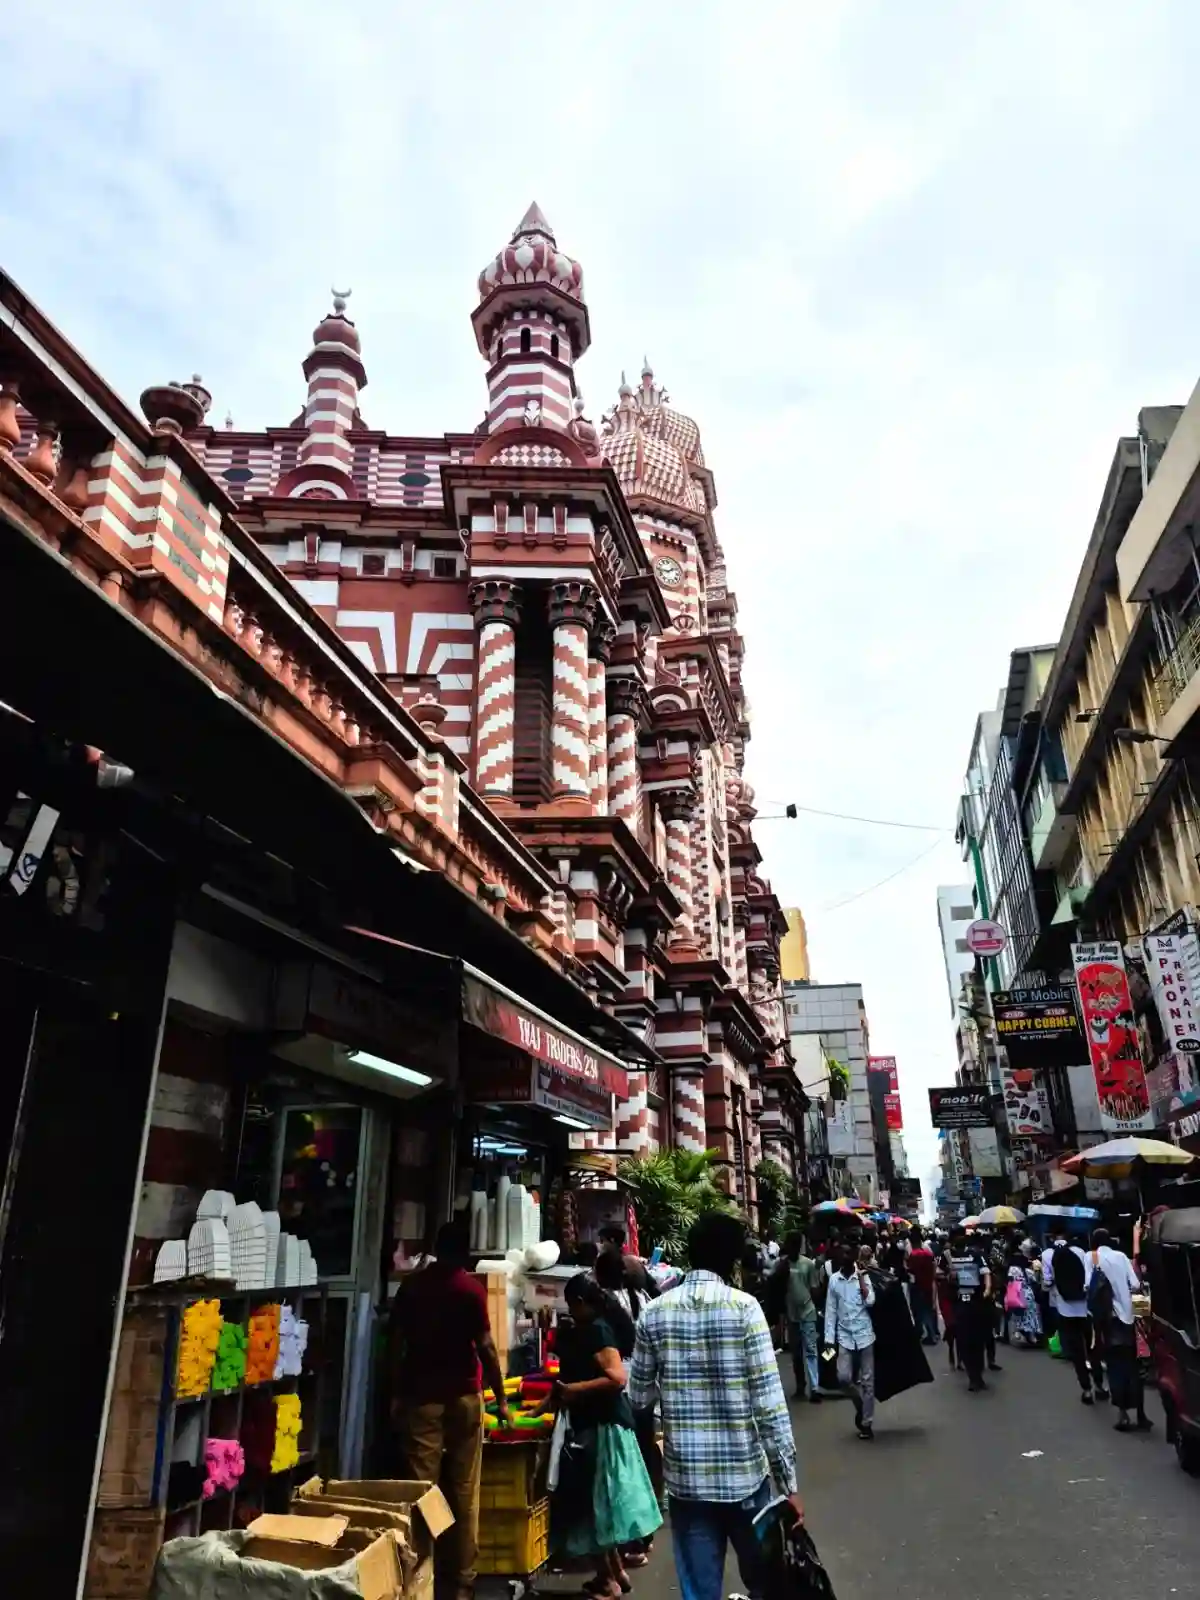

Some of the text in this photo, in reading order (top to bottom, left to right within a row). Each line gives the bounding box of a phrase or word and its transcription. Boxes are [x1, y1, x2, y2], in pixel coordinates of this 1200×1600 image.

[1031, 987, 1071, 1001] Mobile
[1158, 957, 1186, 1037] PHONE
[1172, 960, 1198, 1033] REPAIR
[996, 1015, 1077, 1033] HAPPY CORNER
